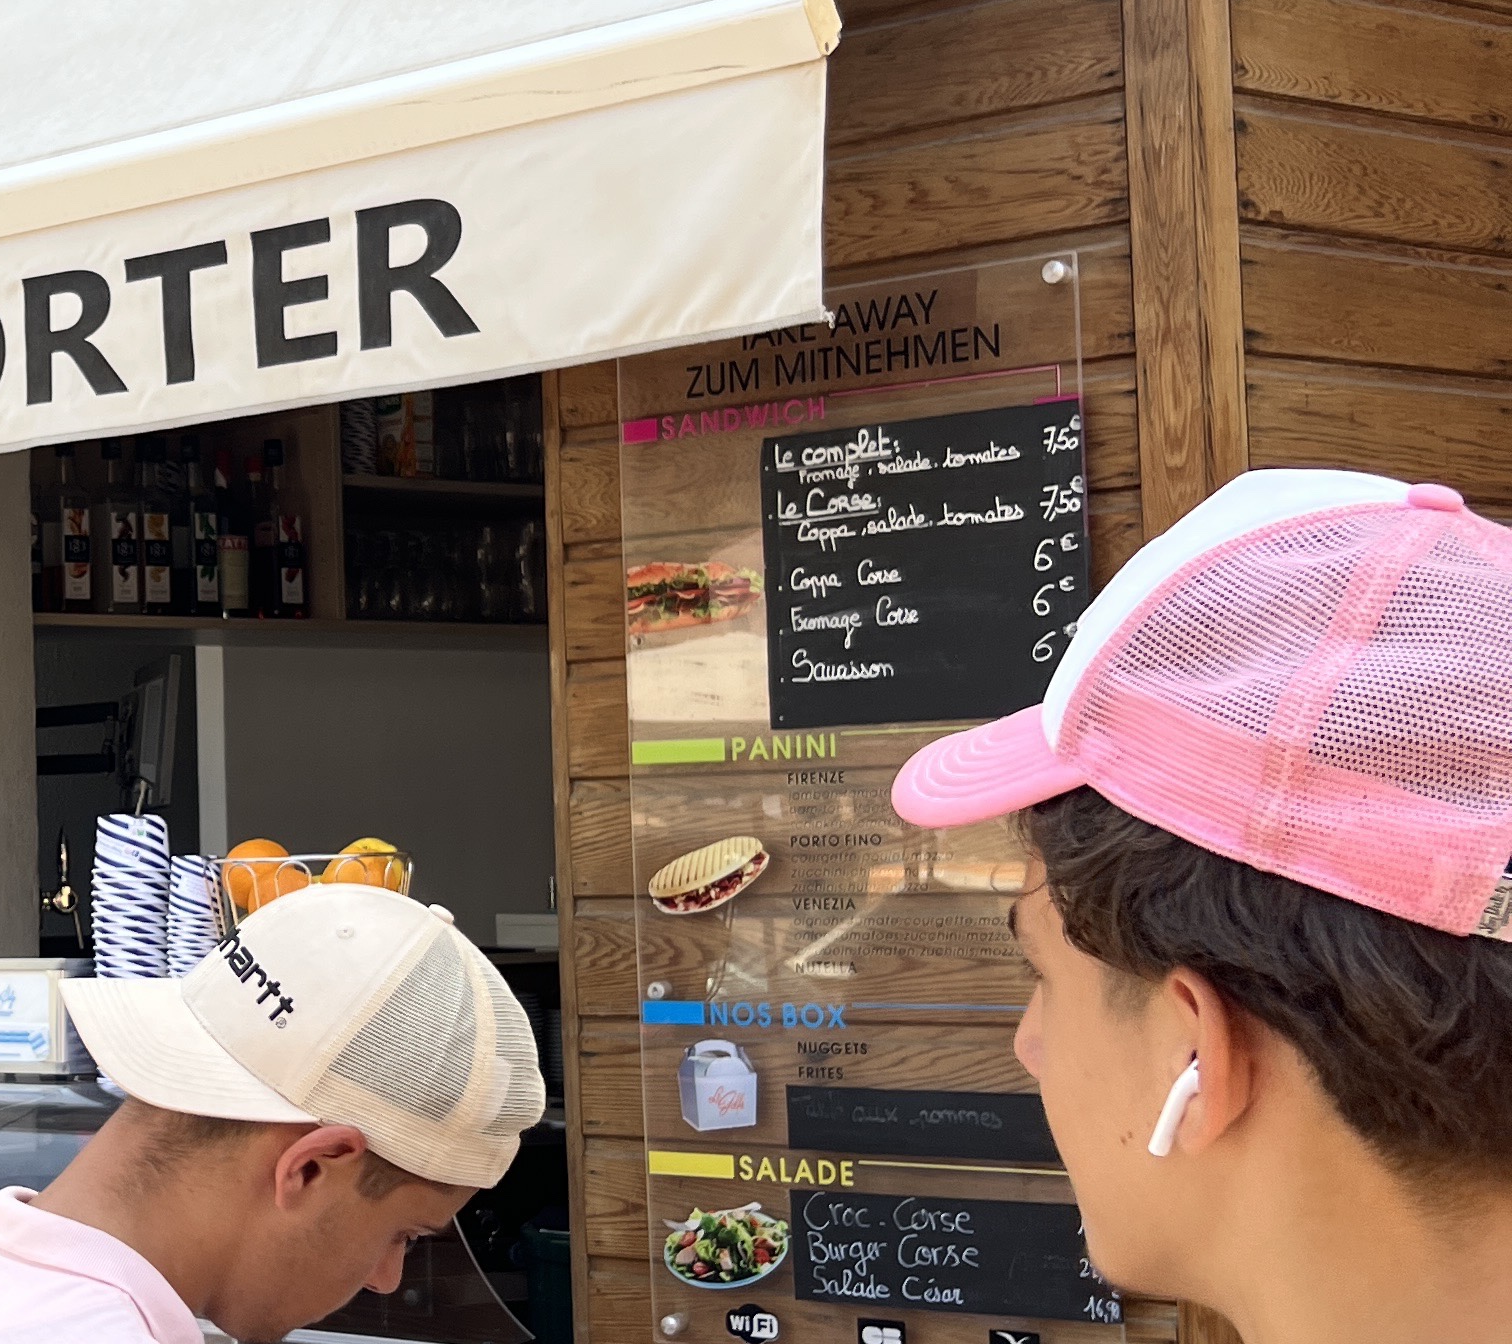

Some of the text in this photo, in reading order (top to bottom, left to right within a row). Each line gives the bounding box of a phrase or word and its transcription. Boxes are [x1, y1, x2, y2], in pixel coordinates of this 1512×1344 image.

[830, 289, 937, 338] AWAY
[686, 324, 1000, 398] ZUM MITNEHMEN
[661, 397, 825, 440] SANDWICH
[774, 443, 795, 469] Le
[943, 441, 1020, 468] tomates
[778, 490, 802, 519] Le
[937, 496, 1024, 526] tomates
[791, 559, 901, 598] Coppa Corse
[791, 595, 919, 649] Fromage Corse
[732, 733, 835, 761] PANINI
[788, 771, 844, 785] FIRENZE
[790, 833, 882, 847] PORTO FINO
[793, 898, 856, 910] VENEZIA
[796, 961, 857, 973] NUTELLA
[710, 1002, 847, 1029] NOS BOX
[797, 1041, 868, 1055] NUGGETS
[798, 1066, 844, 1080] FRITES
[739, 1155, 854, 1187] SALADE
[803, 1191, 870, 1231] Croc
[893, 1197, 974, 1234] Corse
[898, 1234, 979, 1267] Corse
[812, 1266, 964, 1304] Salade César
